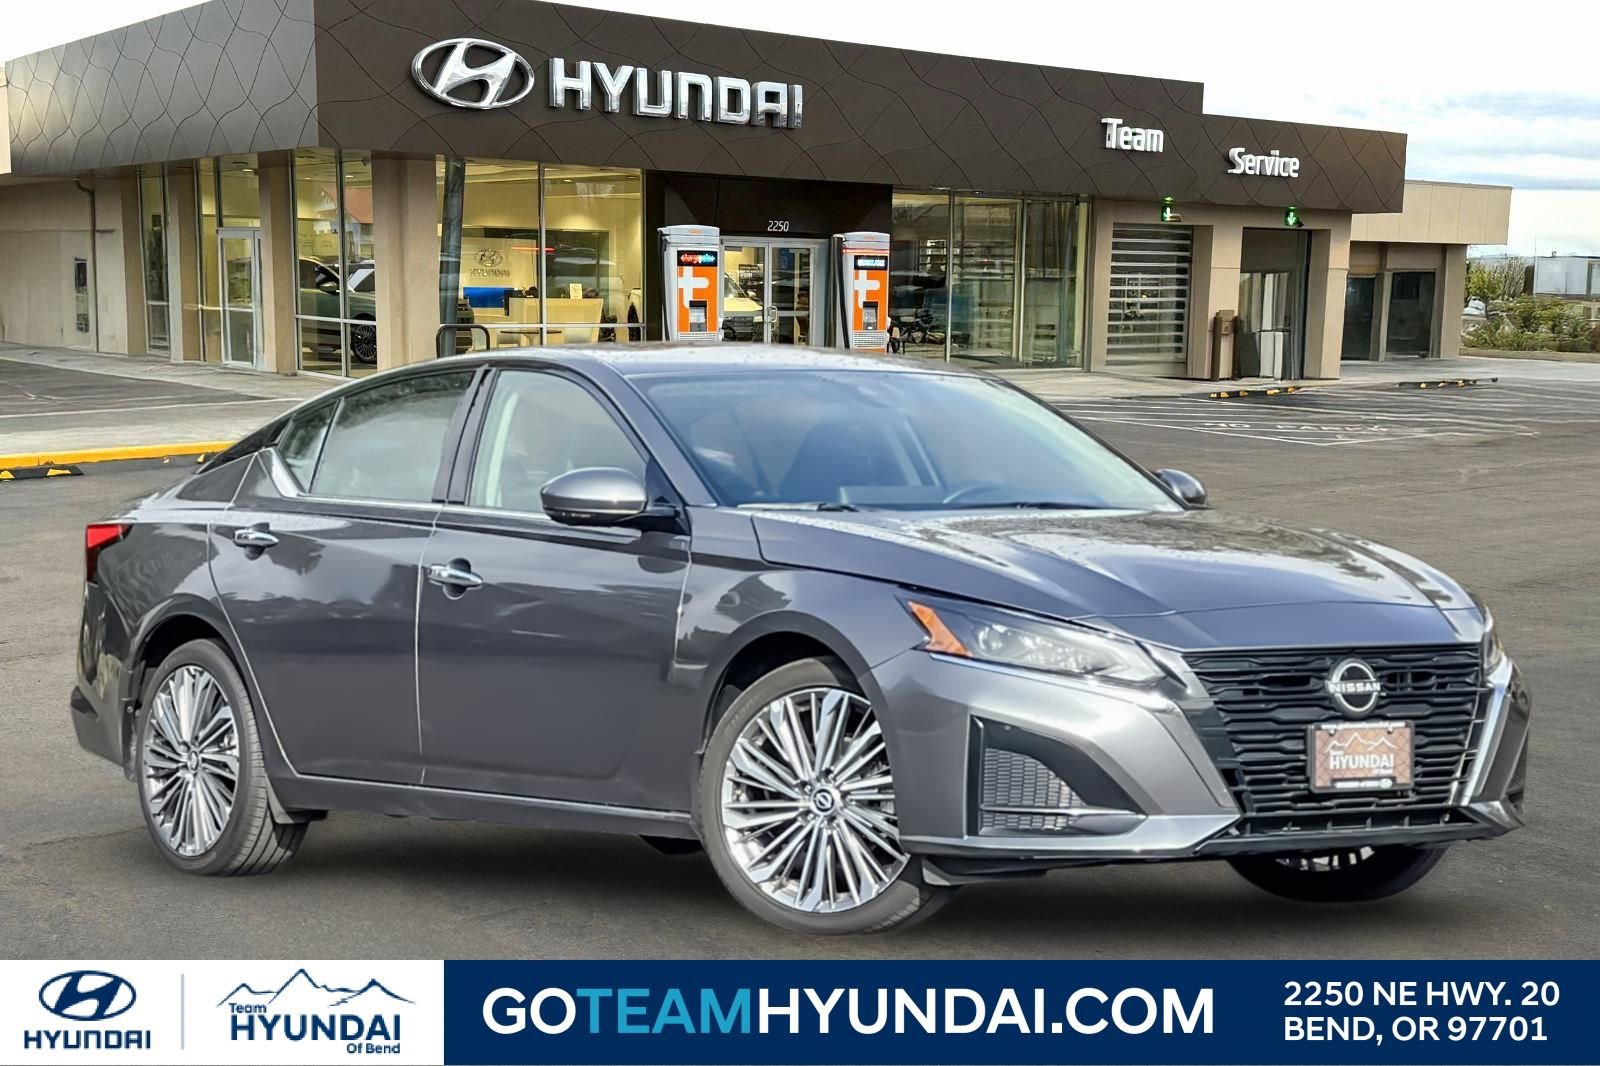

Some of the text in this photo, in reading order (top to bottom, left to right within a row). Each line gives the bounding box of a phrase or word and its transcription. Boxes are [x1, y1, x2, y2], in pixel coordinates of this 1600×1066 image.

[548, 57, 804, 129] HYUNDAI
[1101, 117, 1164, 153] Team
[1227, 147, 1300, 178] Service
[767, 220, 790, 232] 2250
[1328, 681, 1382, 693] NISSAN
[1329, 753, 1395, 770] HYUNDAI
